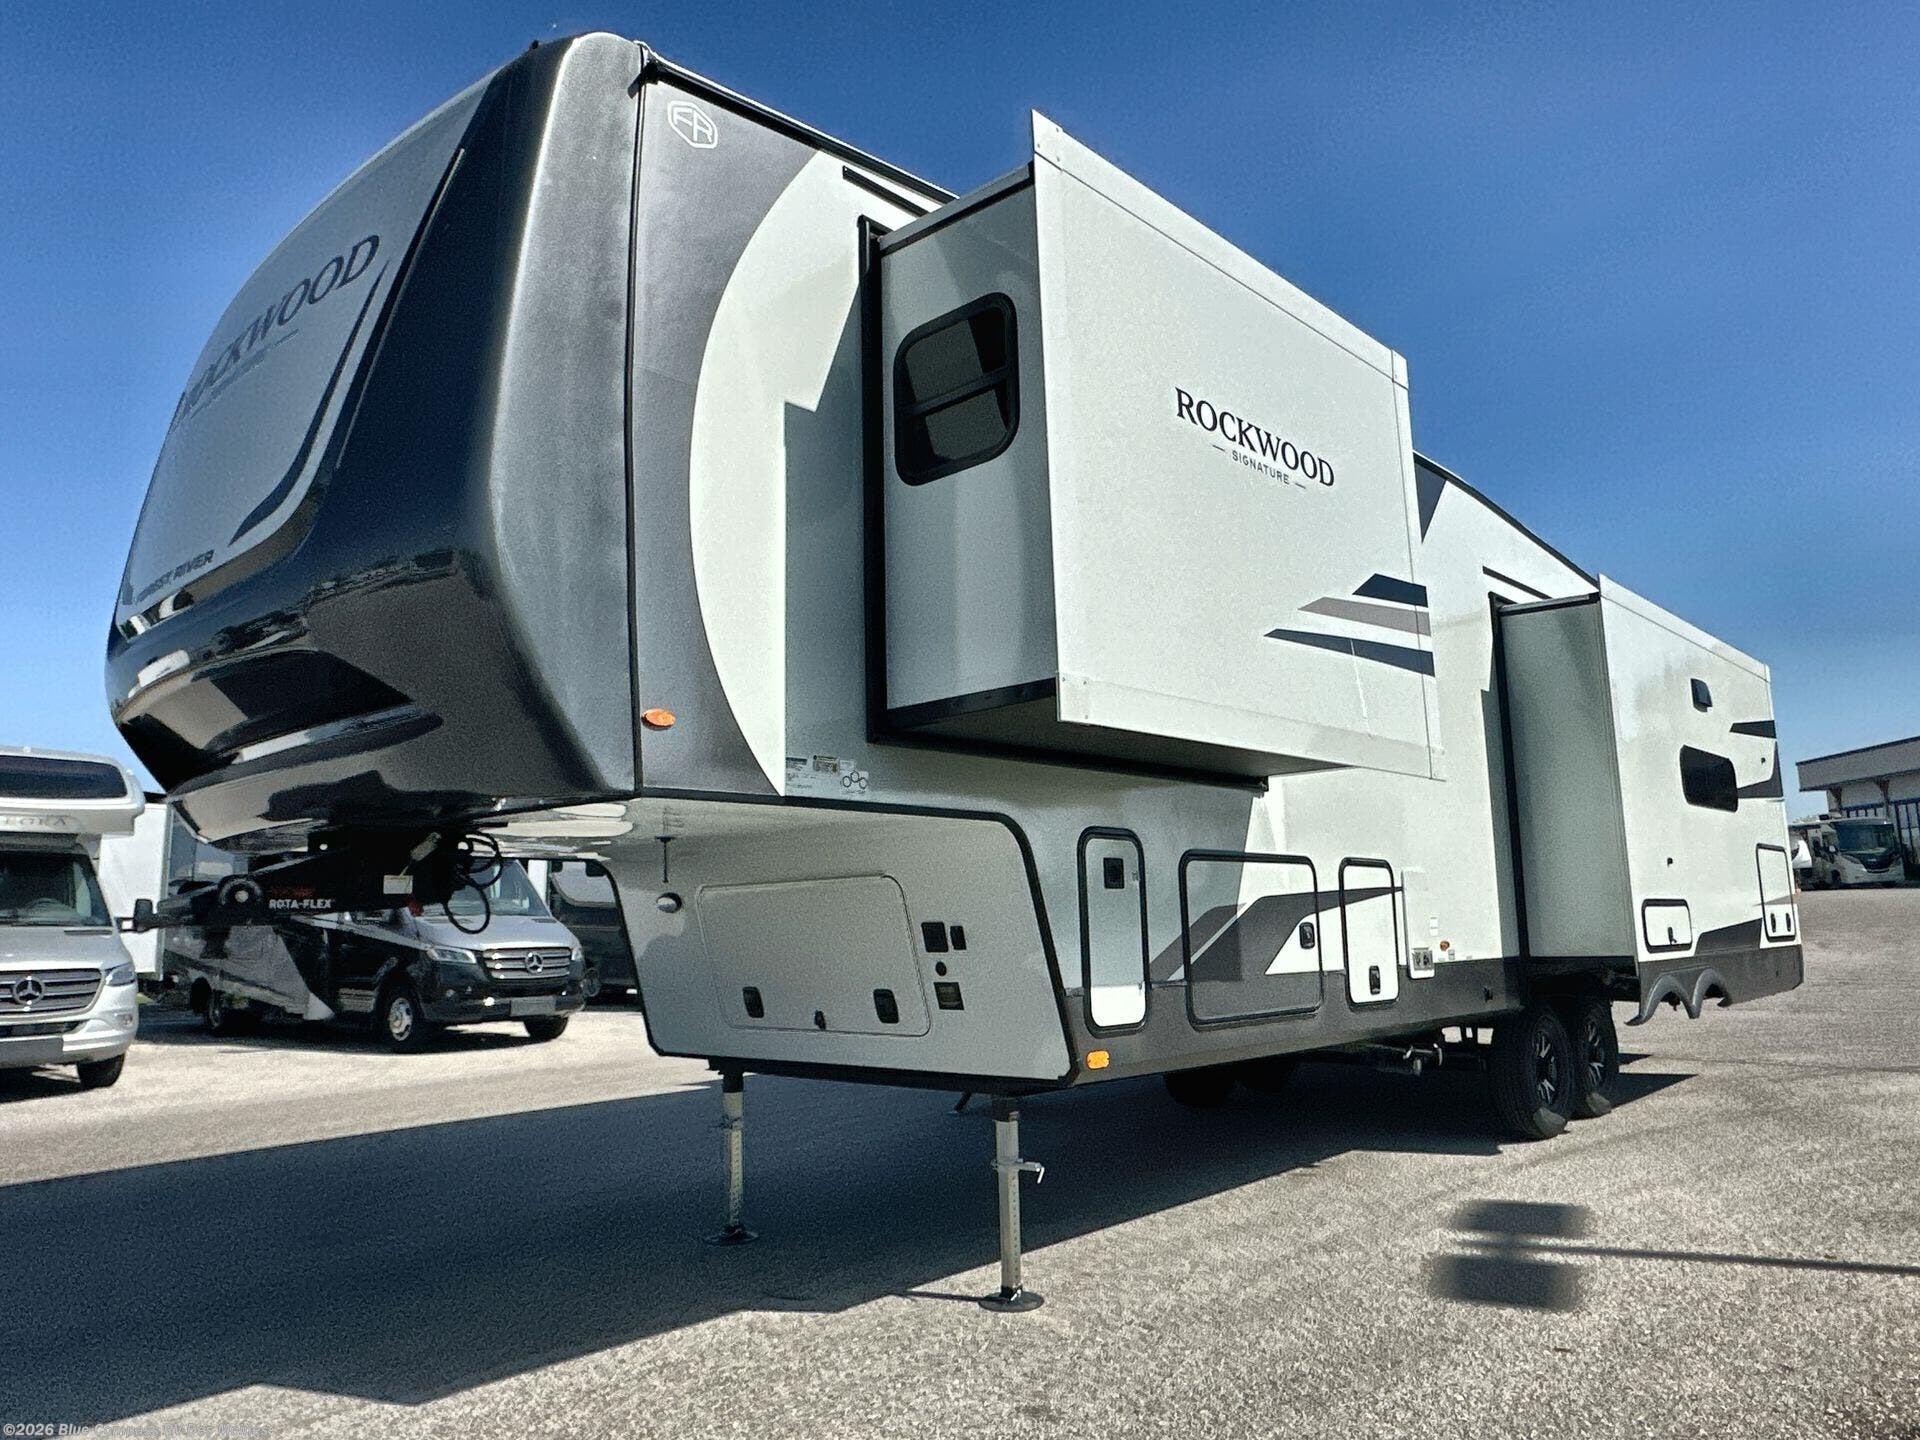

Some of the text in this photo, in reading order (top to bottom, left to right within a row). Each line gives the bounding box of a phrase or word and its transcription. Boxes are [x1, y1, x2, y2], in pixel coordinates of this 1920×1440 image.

[1175, 386, 1335, 487] ROCKWOOD
[1231, 450, 1290, 486] SIGNATURE
[269, 898, 332, 910] ROTA-FLEX
